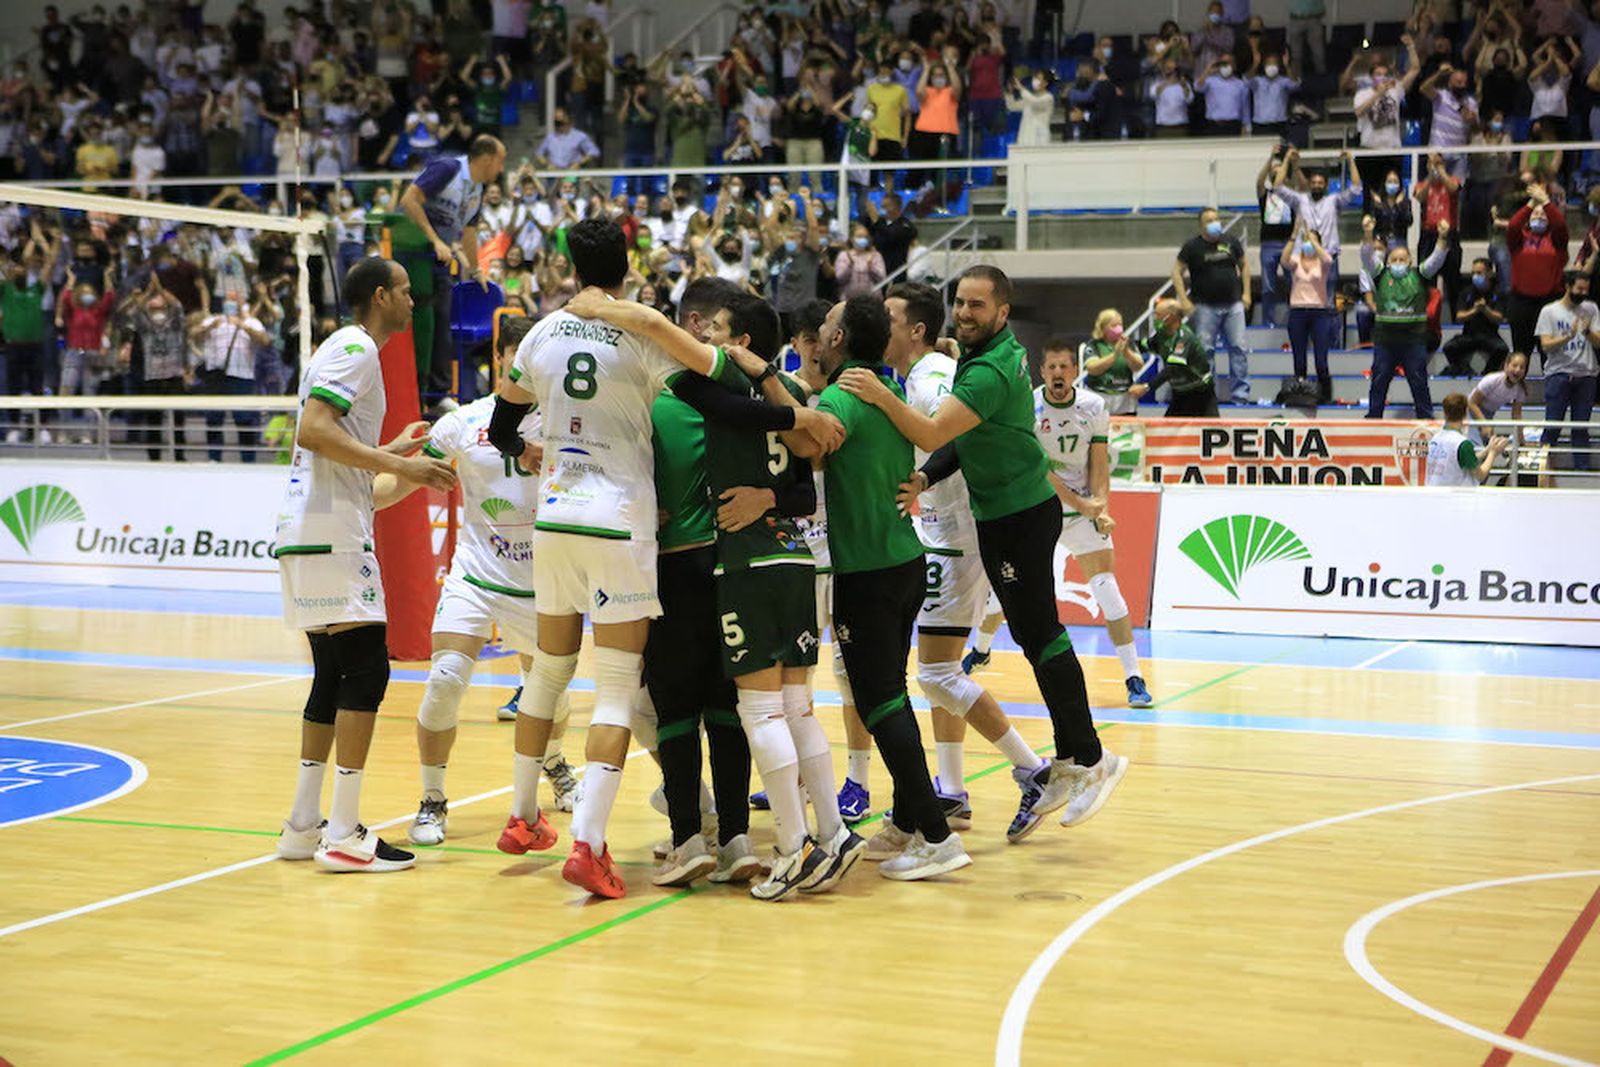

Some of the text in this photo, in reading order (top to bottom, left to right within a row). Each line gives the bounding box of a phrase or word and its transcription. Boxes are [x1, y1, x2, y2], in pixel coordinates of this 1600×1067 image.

[551, 319, 624, 348] J.FERNANDEZ
[563, 351, 598, 400] 8
[766, 431, 789, 477] 5
[1057, 433, 1079, 453] 17
[1201, 421, 1330, 458] PEÑA
[76, 524, 185, 563] Unicaja
[513, 541, 533, 551] COS
[1303, 561, 1470, 610] Unicaja
[720, 611, 745, 647] 5
